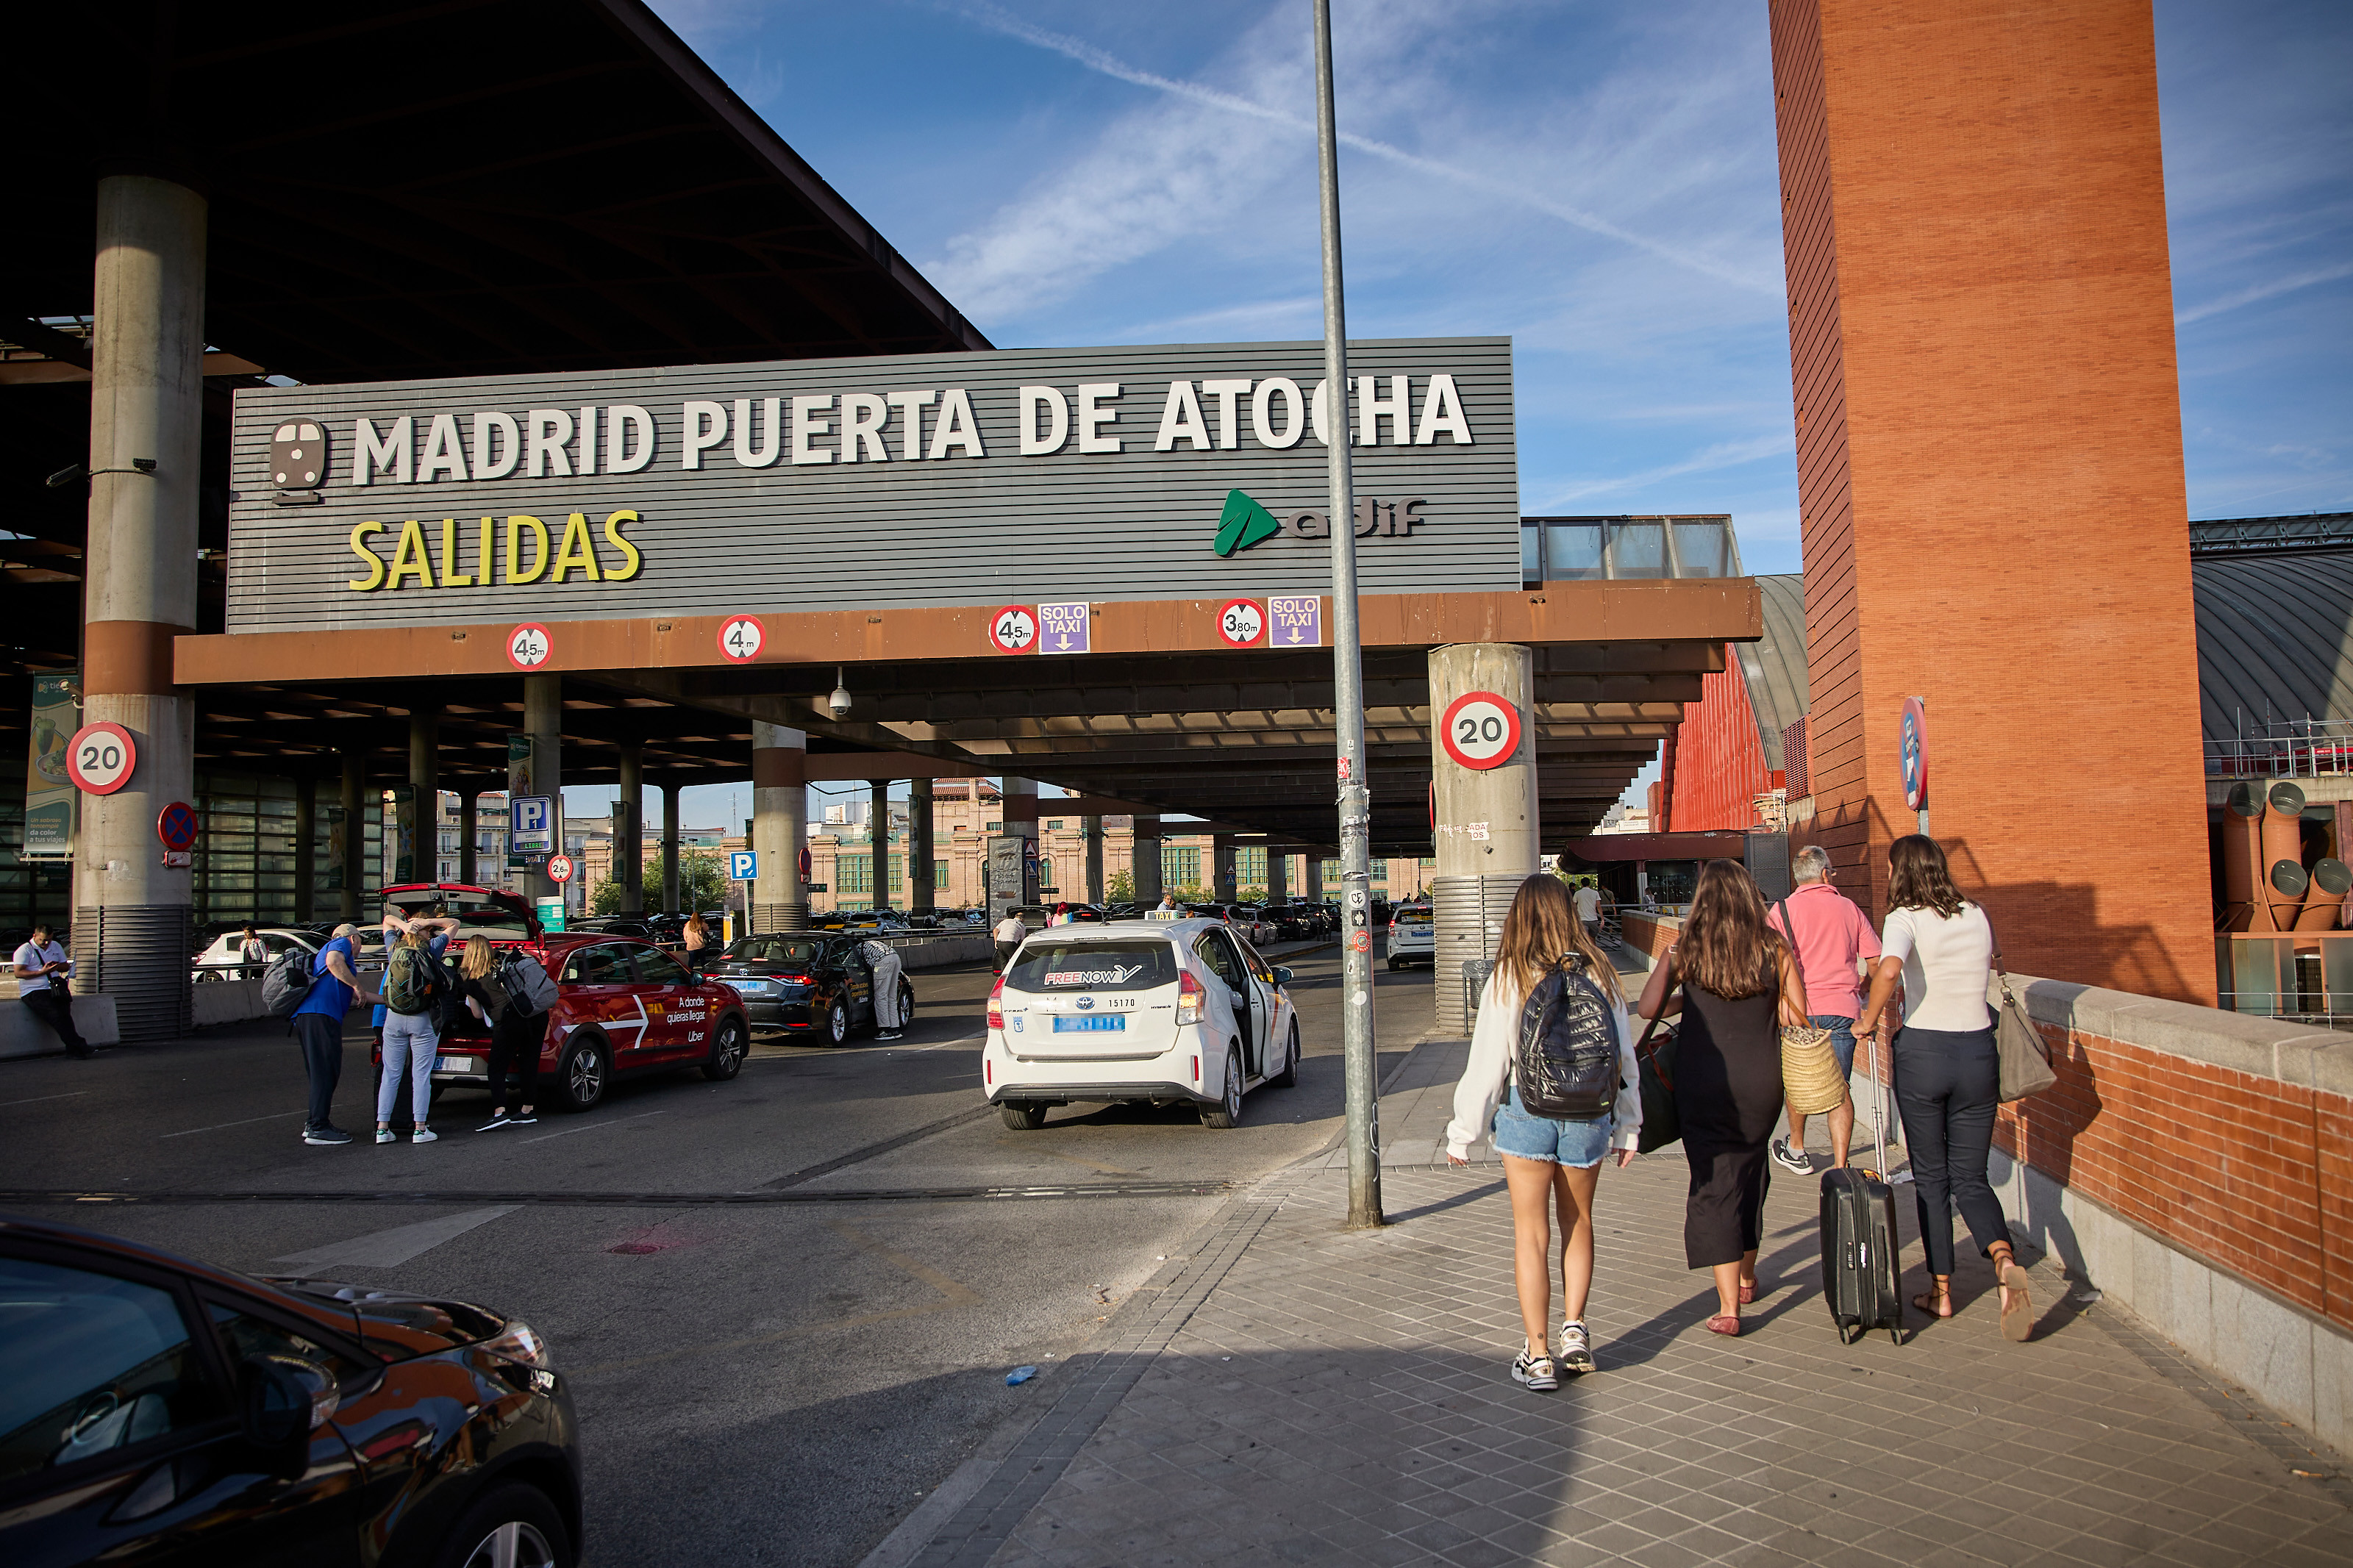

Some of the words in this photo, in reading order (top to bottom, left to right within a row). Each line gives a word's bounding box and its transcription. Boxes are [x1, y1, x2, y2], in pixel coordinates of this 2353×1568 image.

[352, 404, 655, 485] MADRID
[682, 388, 985, 469] PUERTA
[1019, 382, 1121, 456] DE
[349, 509, 640, 590] SALIDAS
[1042, 606, 1085, 620] SOLO
[1273, 599, 1316, 614] SOLO
[1047, 619, 1081, 634] TAXI
[1277, 612, 1312, 627] TAXI
[1458, 716, 1502, 744] 20
[82, 746, 120, 770] 20
[520, 802, 542, 830] P
[532, 819, 538, 829] 1
[46, 836, 65, 844] viajes
[735, 854, 753, 877] P
[1154, 912, 1172, 920] TAXI
[679, 997, 685, 1008] A
[685, 995, 705, 1008] donde
[1109, 998, 1135, 1008] 15170
[667, 1011, 689, 1025] quieras
[688, 1031, 704, 1042] Uber
